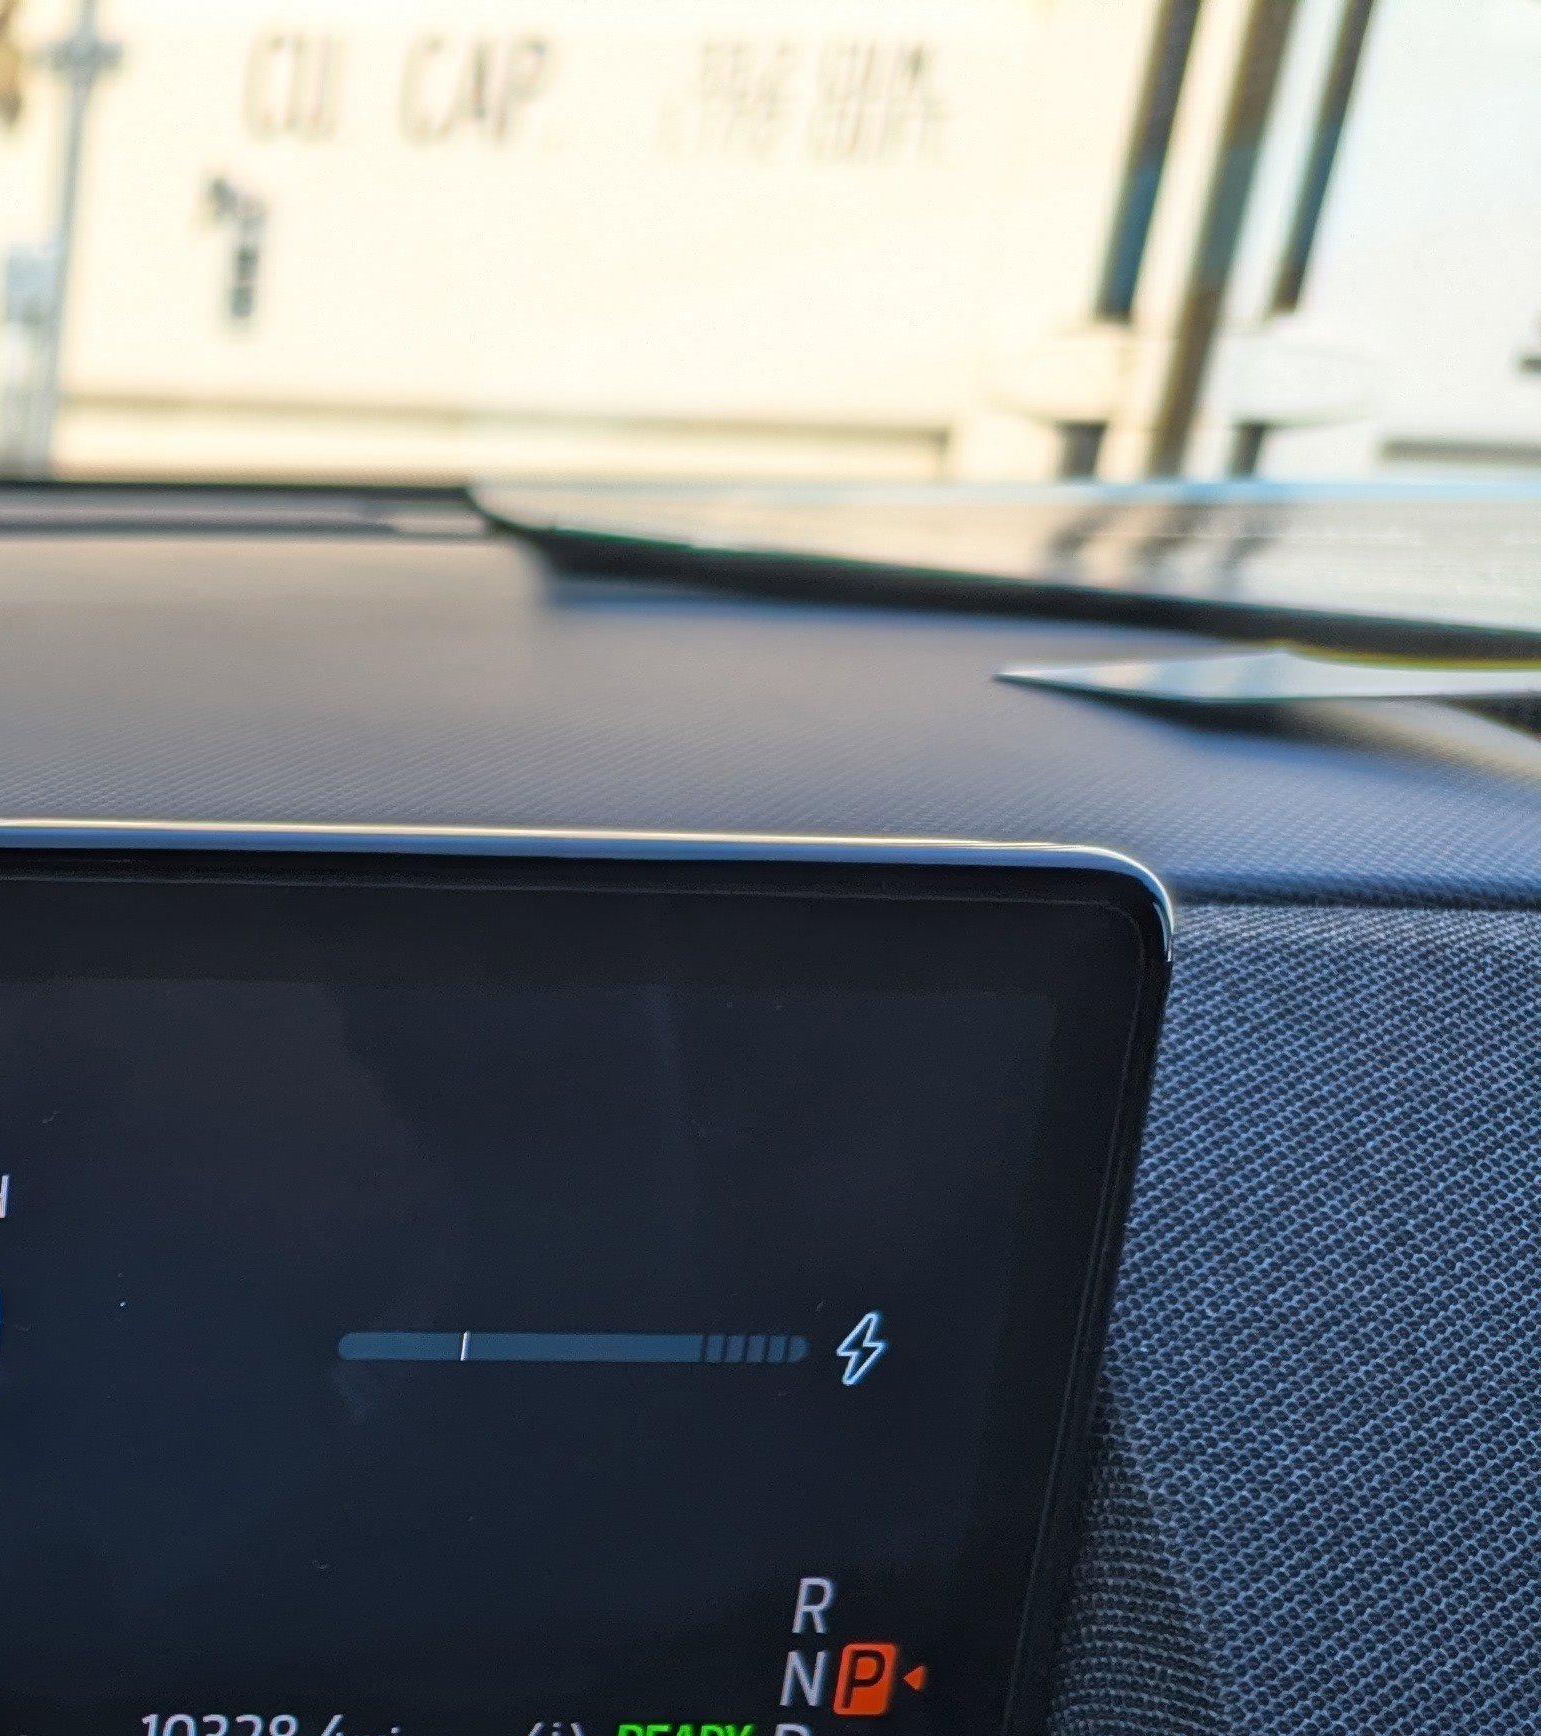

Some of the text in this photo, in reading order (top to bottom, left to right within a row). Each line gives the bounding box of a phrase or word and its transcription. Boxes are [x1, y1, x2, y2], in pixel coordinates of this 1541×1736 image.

[792, 1576, 834, 1633] R
[779, 1650, 826, 1706] N
[841, 1650, 886, 1709] P
